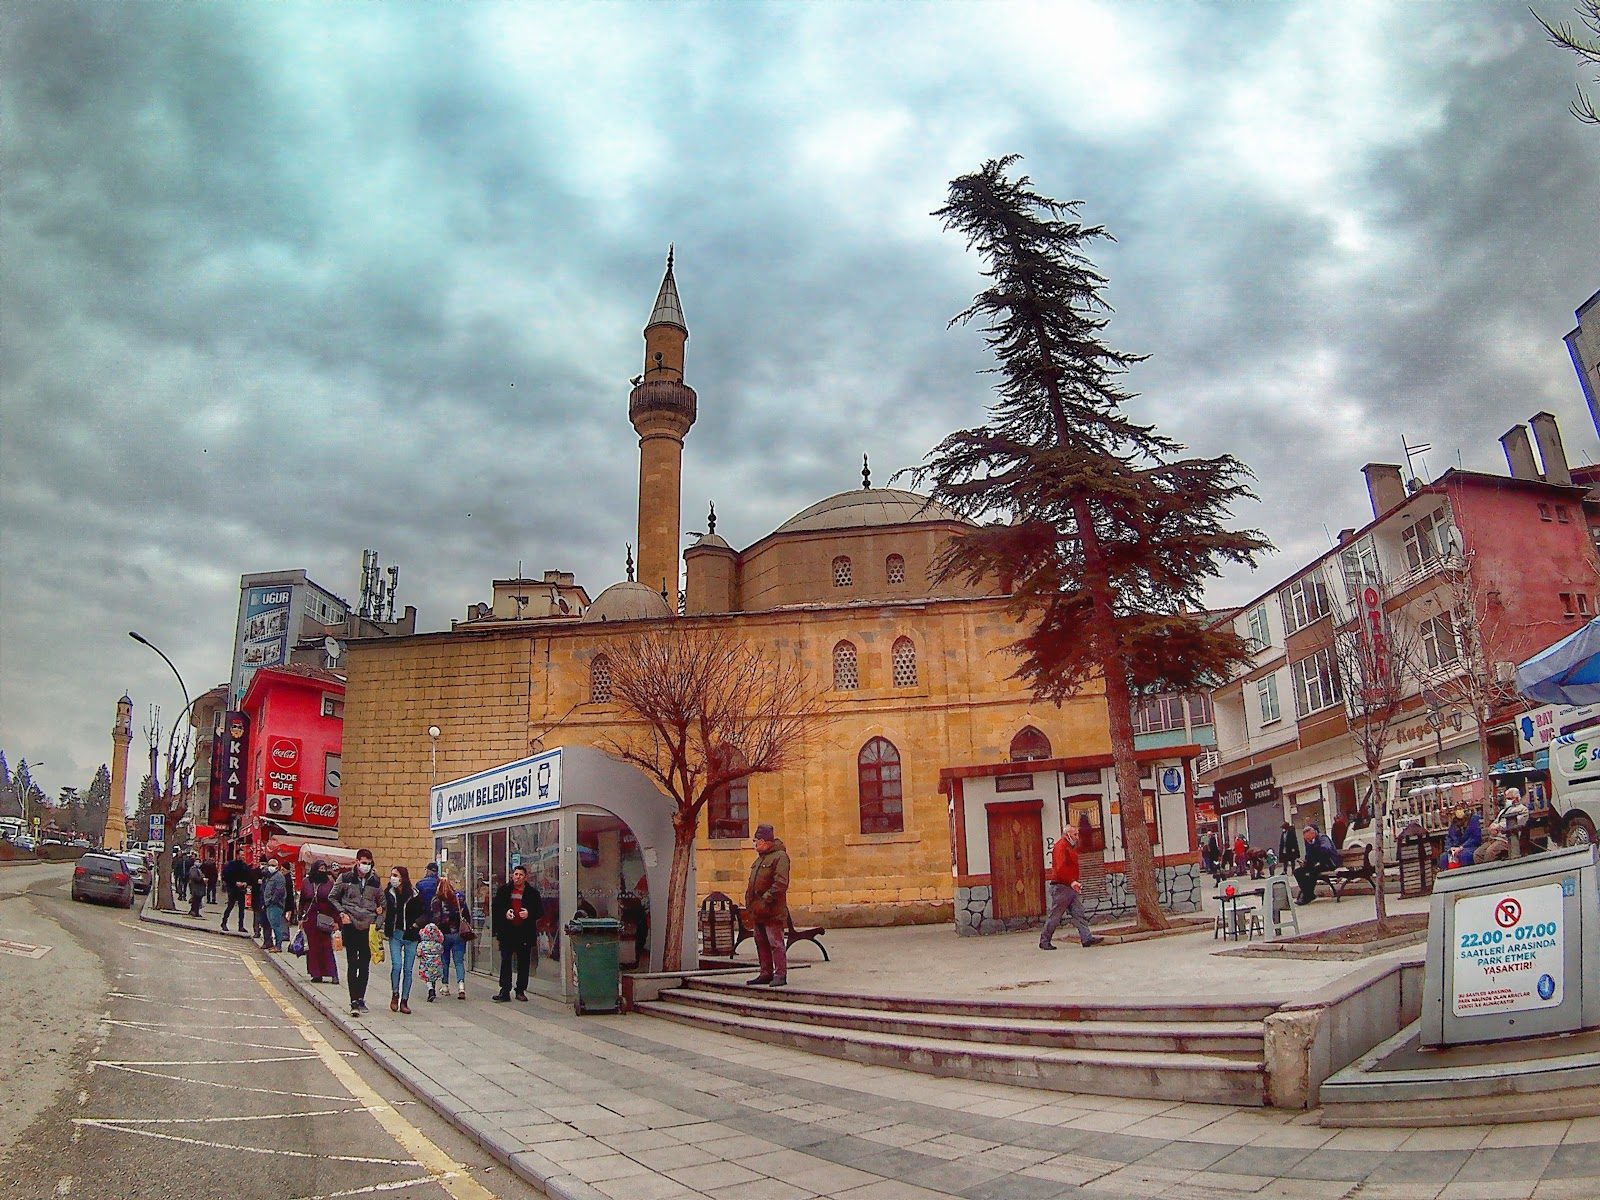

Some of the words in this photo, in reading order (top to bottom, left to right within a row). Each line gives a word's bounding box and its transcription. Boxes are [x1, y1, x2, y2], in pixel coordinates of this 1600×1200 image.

[1535, 711, 1553, 728] BAY
[1539, 727, 1555, 743] WC
[228, 741, 240, 800] KRAL
[270, 771, 297, 782] CADDE
[273, 781, 294, 791] BÜFE
[448, 790, 475, 815] ÇORUM
[476, 769, 532, 806] BELEDİYESİ
[1461, 930, 1503, 948] 22.00
[1515, 922, 1557, 940] 07.00
[1461, 945, 1505, 959] SAATLERİ
[1507, 939, 1556, 953] ARASINDA
[1478, 955, 1502, 967] PARK
[1505, 951, 1537, 963] ETMEK
[1484, 962, 1532, 975] YASAKTIR!
